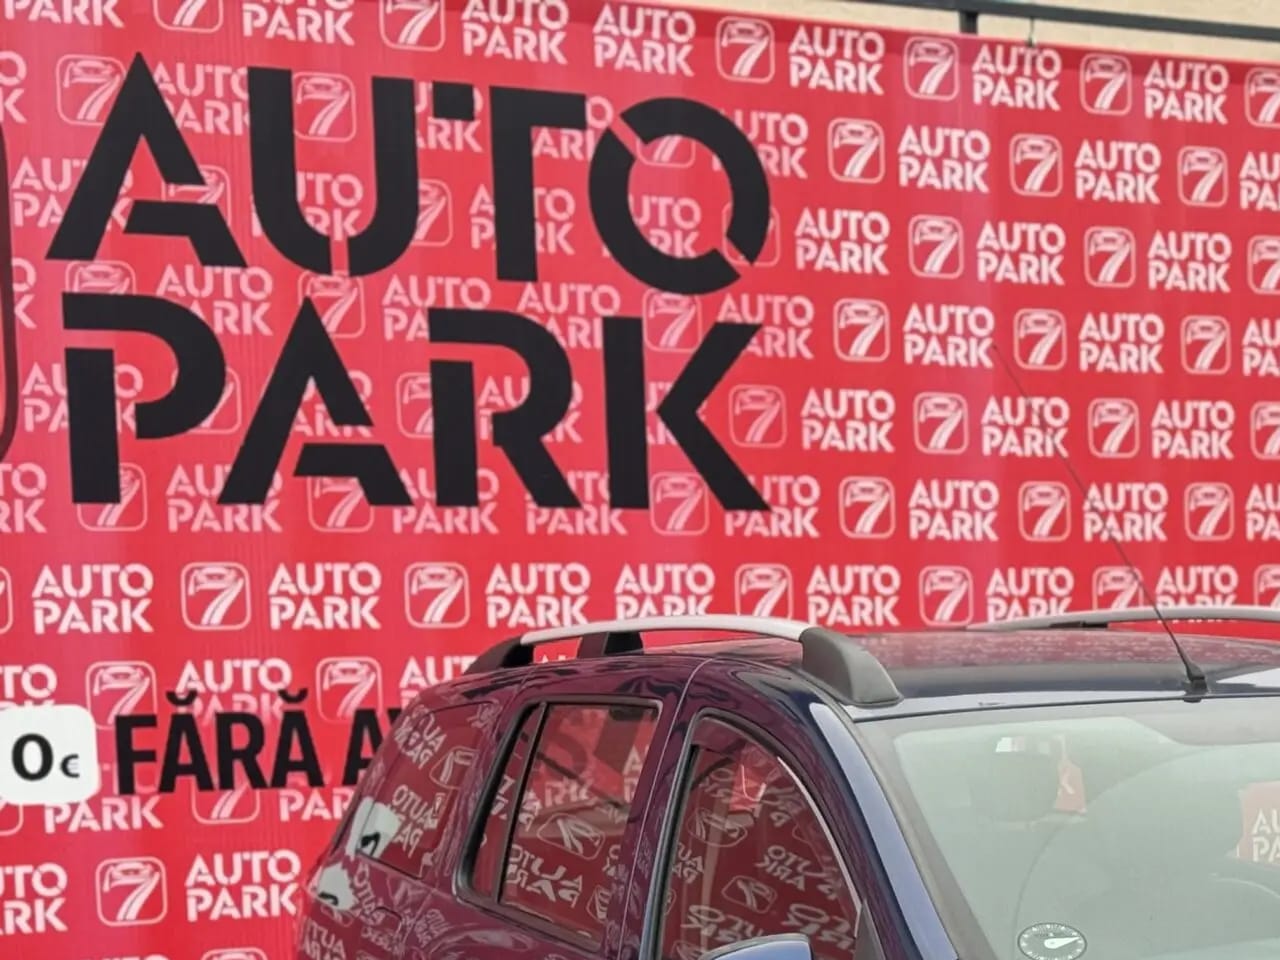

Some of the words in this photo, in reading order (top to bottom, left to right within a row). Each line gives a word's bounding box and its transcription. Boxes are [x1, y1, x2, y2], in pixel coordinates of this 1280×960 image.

[243, 6, 355, 45] PARK
[462, 0, 569, 30] AUTO
[593, 3, 696, 43] AUTO
[462, 24, 568, 64] PARK
[593, 36, 695, 76] PARK
[788, 26, 884, 62] AUTO
[788, 58, 883, 95] PARK
[972, 44, 1061, 81] AUTO
[1144, 60, 1229, 94] AUTO
[972, 76, 1059, 111] PARK
[1144, 92, 1227, 124] PARK
[898, 126, 989, 159] AUTO
[1075, 141, 1160, 174] AUTO
[46, 52, 771, 295] AUTO
[899, 156, 988, 192] PARK
[1075, 172, 1159, 204] PARK
[794, 208, 889, 244] AUTO
[976, 222, 1065, 256] AUTO
[796, 239, 889, 276] PARK
[1148, 232, 1231, 263] AUTO
[157, 265, 273, 300] AUTO
[977, 253, 1064, 286] PARK
[1148, 261, 1230, 293] PARK
[382, 274, 491, 310] AUTO
[517, 281, 621, 316] AUTO
[717, 293, 815, 326] AUTO
[903, 305, 994, 337] AUTO
[1078, 313, 1164, 344] AUTO
[903, 334, 993, 368] PARK
[1079, 342, 1162, 374] PARK
[61, 290, 773, 511] PARK
[801, 389, 894, 422] AUTO
[981, 396, 1069, 429] AUTO
[1151, 401, 1234, 432] AUTO
[802, 419, 894, 452] PARK
[981, 426, 1068, 458] PARK
[1152, 429, 1233, 461] PARK
[908, 480, 999, 512] AUTO
[1082, 482, 1168, 513] AUTO
[167, 498, 283, 533] PARK
[724, 507, 820, 538] PARK
[909, 510, 998, 542] PARK
[1083, 511, 1167, 542] PARK
[32, 563, 154, 598] AUTO
[269, 562, 382, 597] AUTO
[485, 563, 592, 595] AUTO
[615, 563, 715, 595] AUTO
[806, 565, 900, 597] AUTO
[986, 566, 1074, 598] AUTO
[1156, 566, 1239, 596] AUTO
[33, 597, 154, 635] PARK
[269, 595, 382, 631] PARK
[486, 596, 591, 629] PARK
[807, 595, 899, 627] PARK
[175, 657, 292, 693] AUTO
[113, 687, 325, 796] FĂRĂ
[45, 799, 164, 834] PARK
[185, 849, 301, 888] AUTO
[187, 882, 299, 924] PARK
